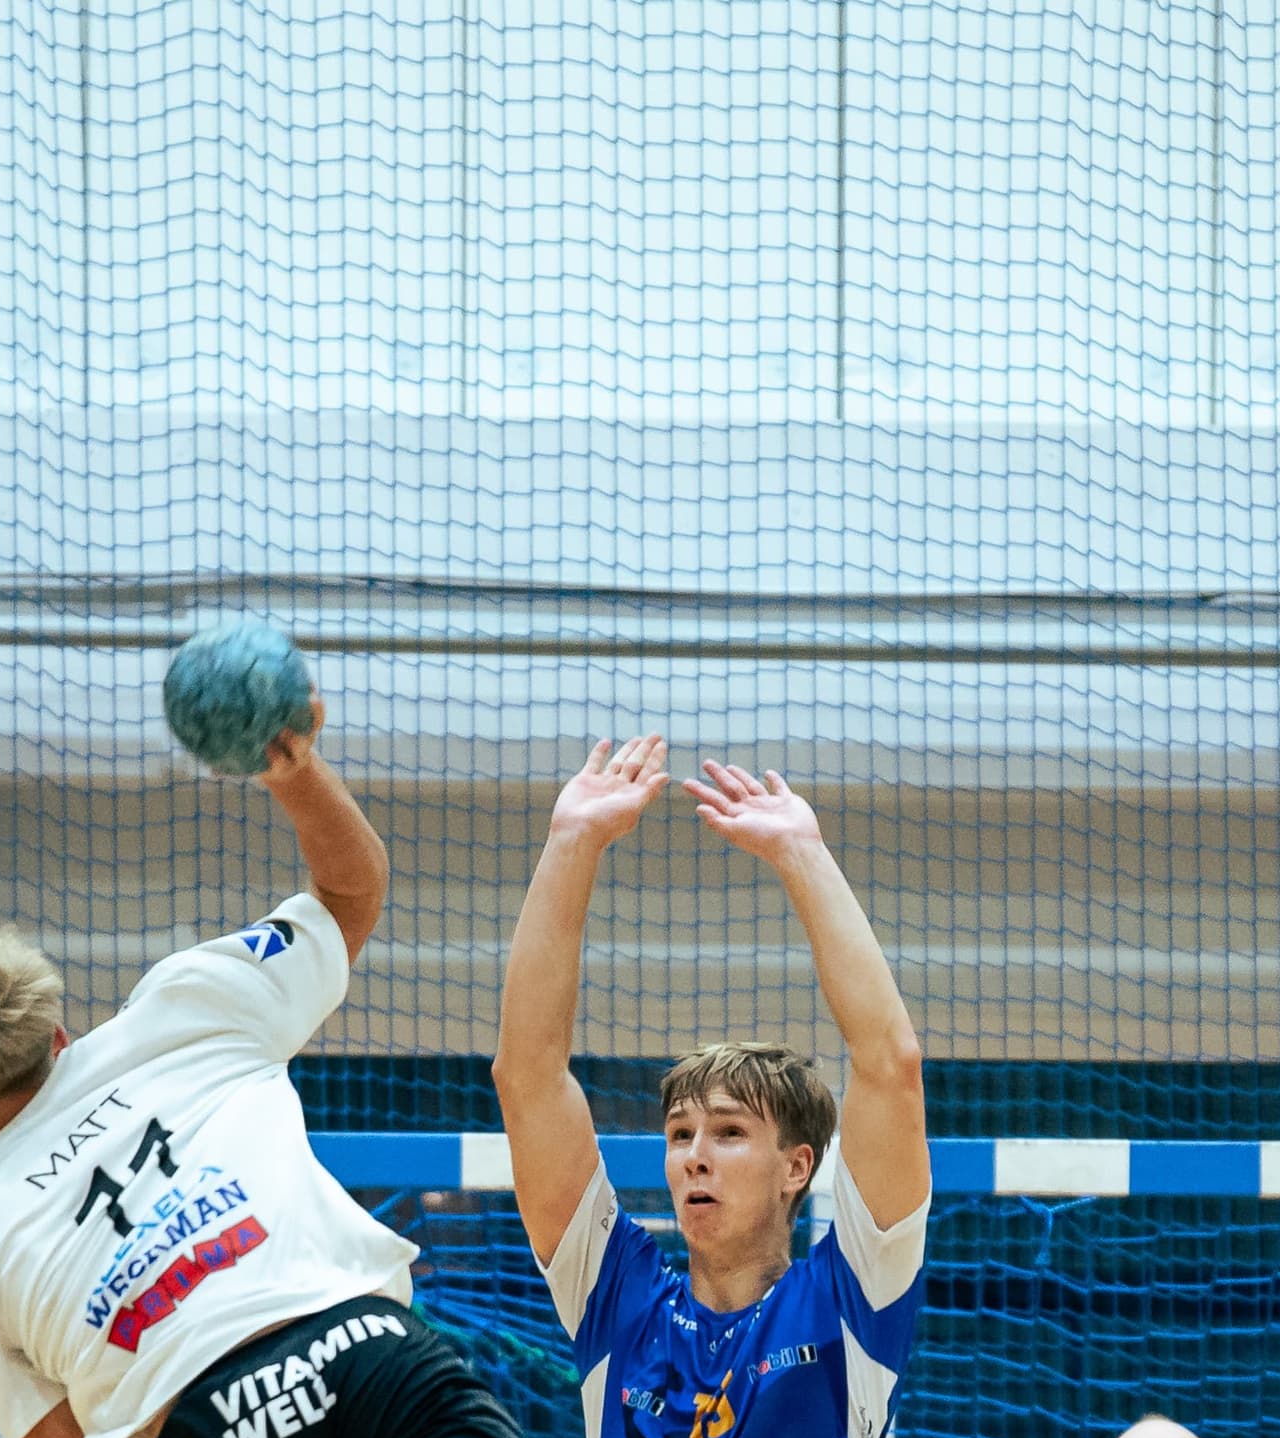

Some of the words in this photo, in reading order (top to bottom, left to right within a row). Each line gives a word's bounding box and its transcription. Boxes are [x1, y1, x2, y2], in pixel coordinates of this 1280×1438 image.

[25, 1088, 132, 1190] MATT
[119, 1226, 260, 1343] PRIMA
[209, 1314, 408, 1426] VITAMIN
